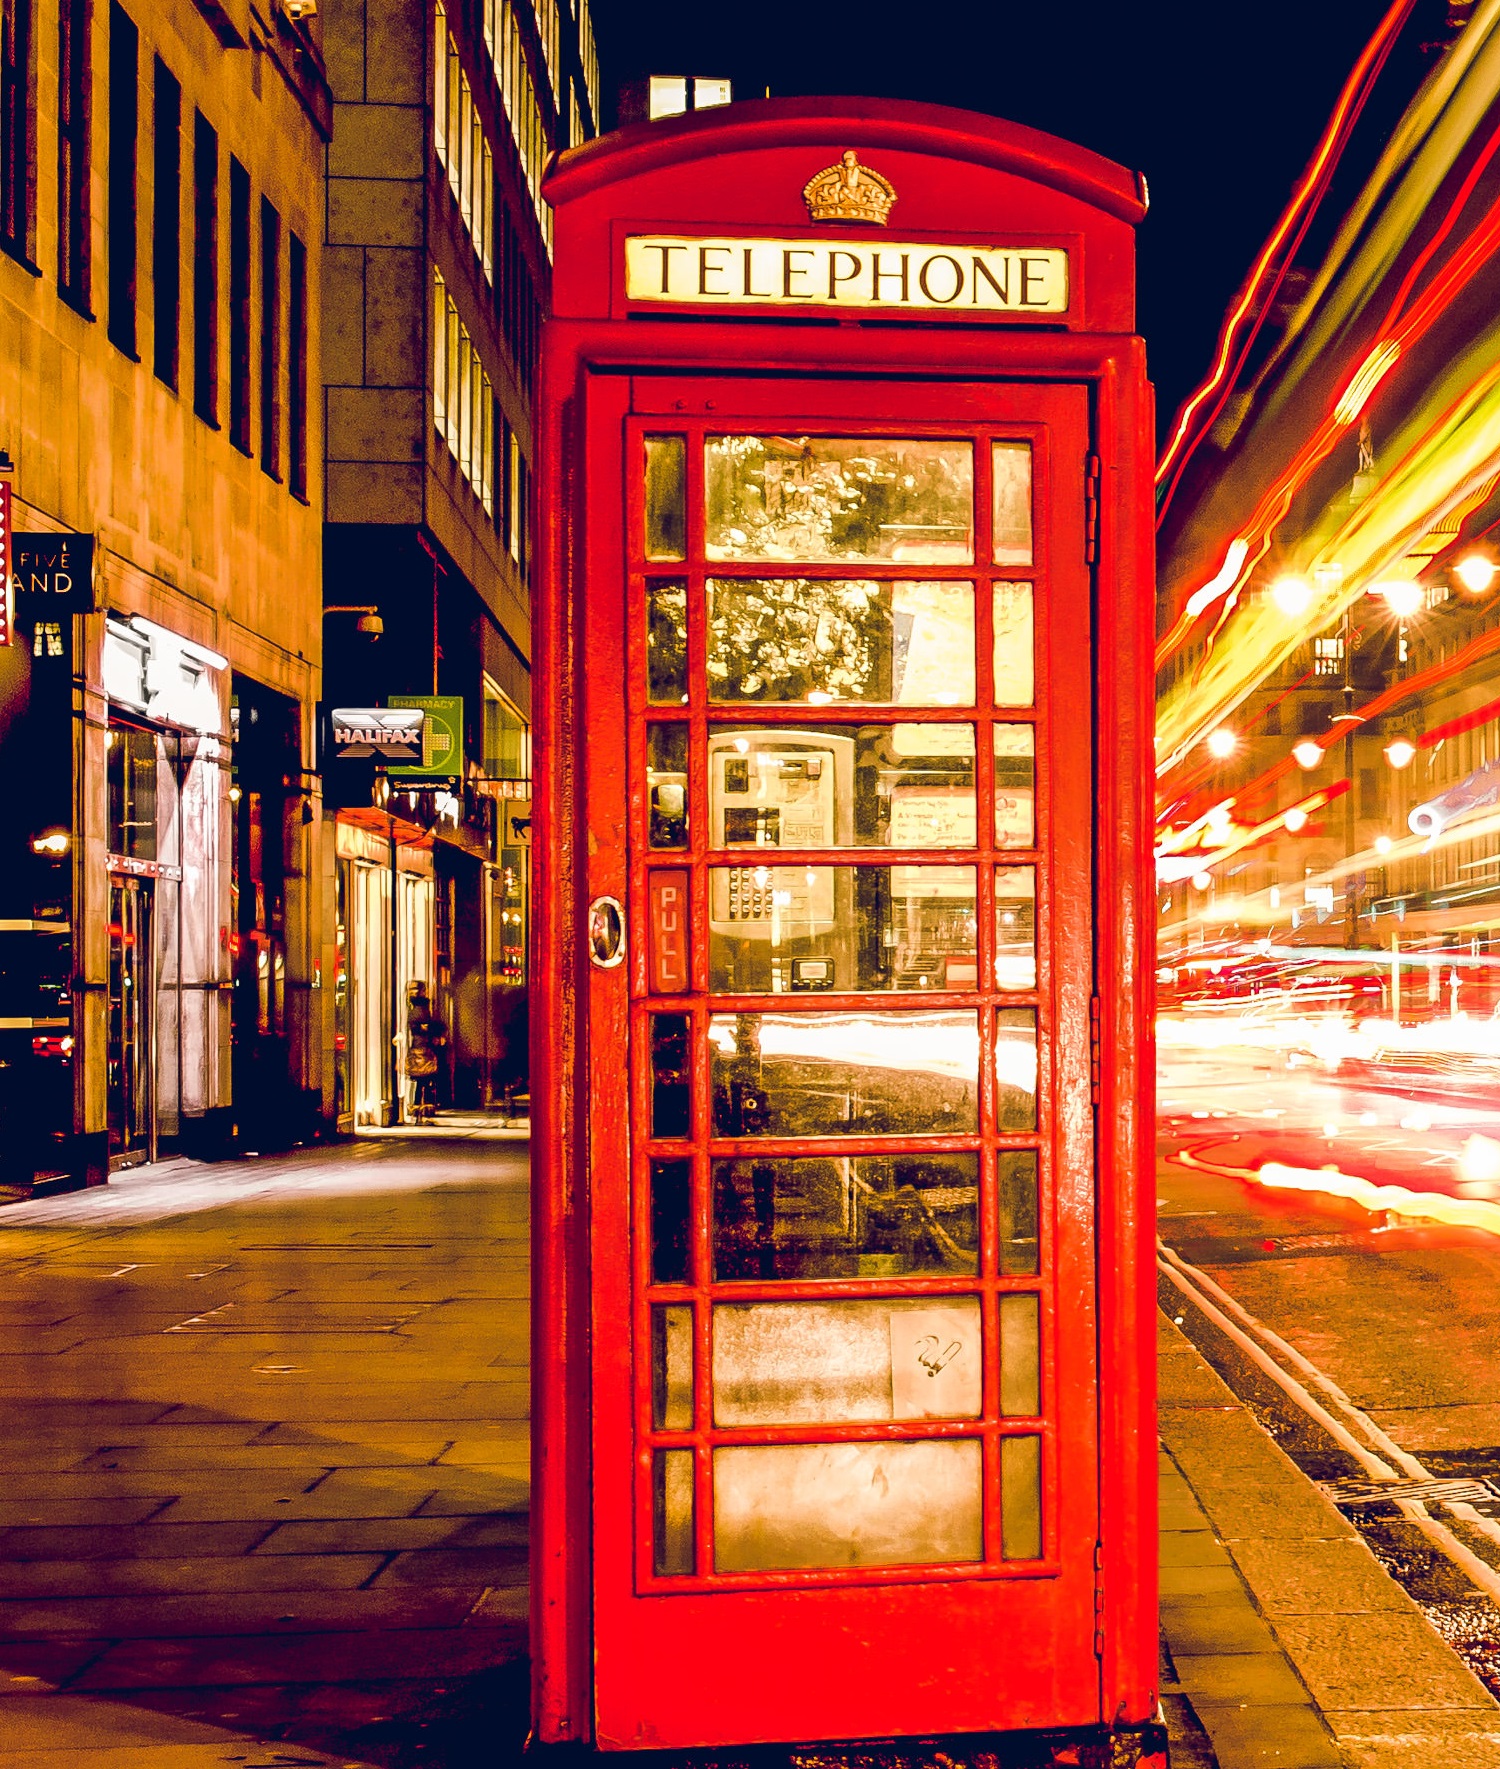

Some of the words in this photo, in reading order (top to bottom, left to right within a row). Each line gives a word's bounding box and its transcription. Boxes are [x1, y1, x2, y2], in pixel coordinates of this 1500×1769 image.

[643, 245, 1051, 306] TELEPHONE
[20, 552, 71, 569] FIVE
[393, 700, 455, 709] PHARMACY
[334, 728, 420, 744] HALIFAX
[393, 781, 451, 792] Superdrug
[661, 886, 678, 979] PULL
